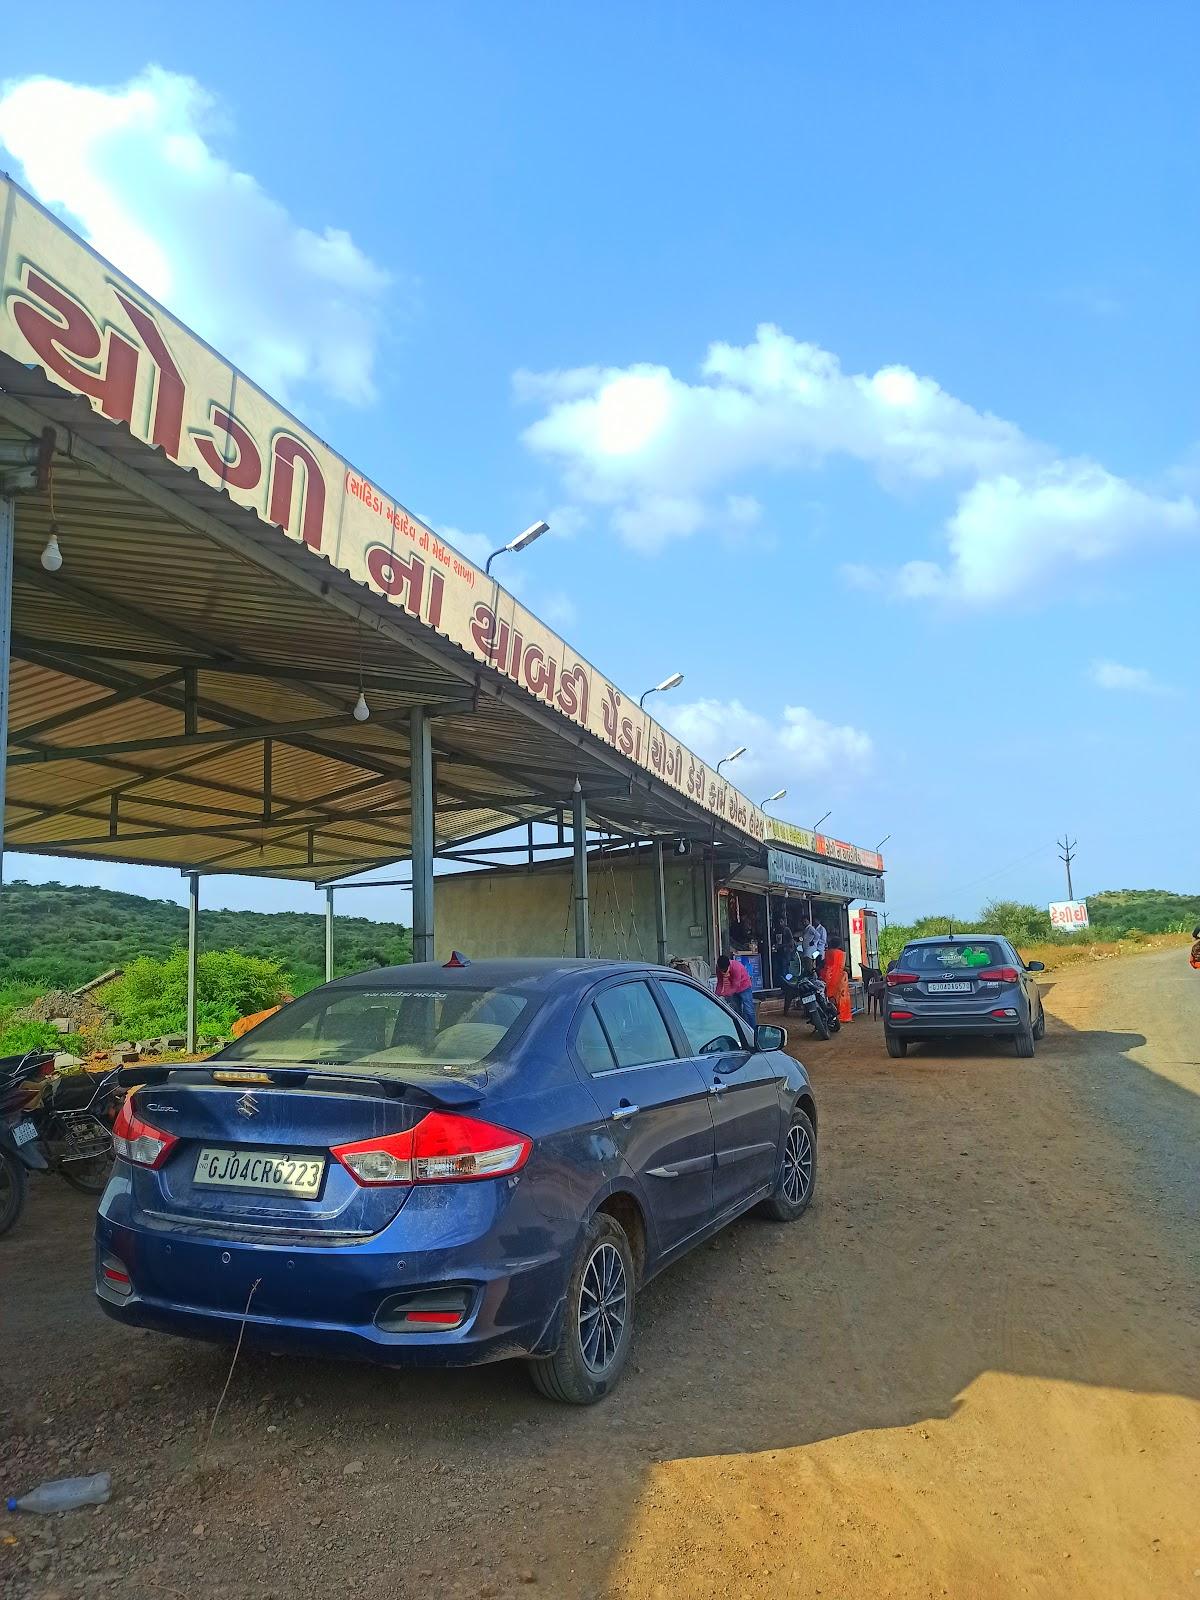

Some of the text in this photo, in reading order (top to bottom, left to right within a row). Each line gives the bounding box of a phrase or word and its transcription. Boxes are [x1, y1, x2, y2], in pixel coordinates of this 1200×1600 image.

[386, 506, 416, 541] મહાદેવ
[366, 546, 446, 628] ના
[470, 601, 589, 725] થાબડી
[651, 728, 683, 786] યોગી
[686, 752, 706, 801] ડેરી
[208, 1156, 321, 1188] GJ04CR6223
